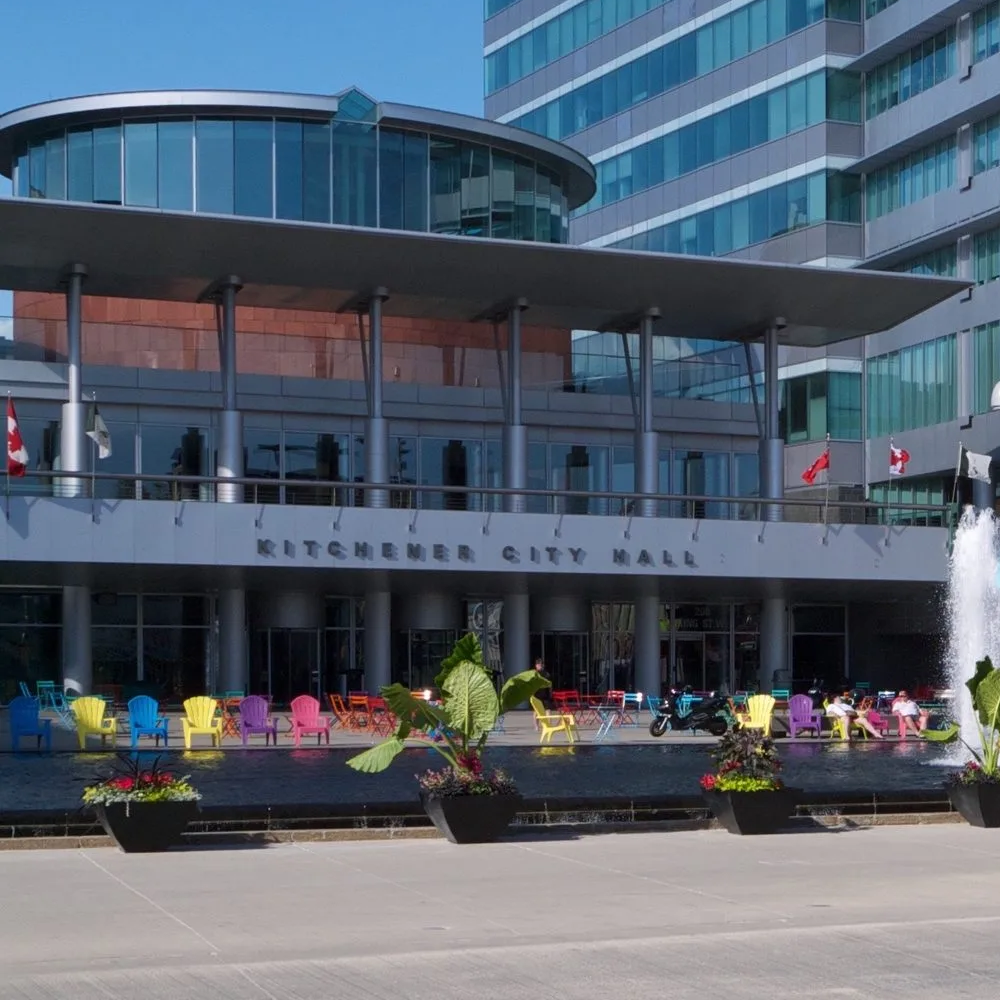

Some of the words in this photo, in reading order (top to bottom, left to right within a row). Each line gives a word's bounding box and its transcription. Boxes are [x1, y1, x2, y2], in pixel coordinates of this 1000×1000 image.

[256, 539, 473, 562] KITCHENER
[502, 545, 586, 565] CITY
[612, 548, 697, 567] HALL
